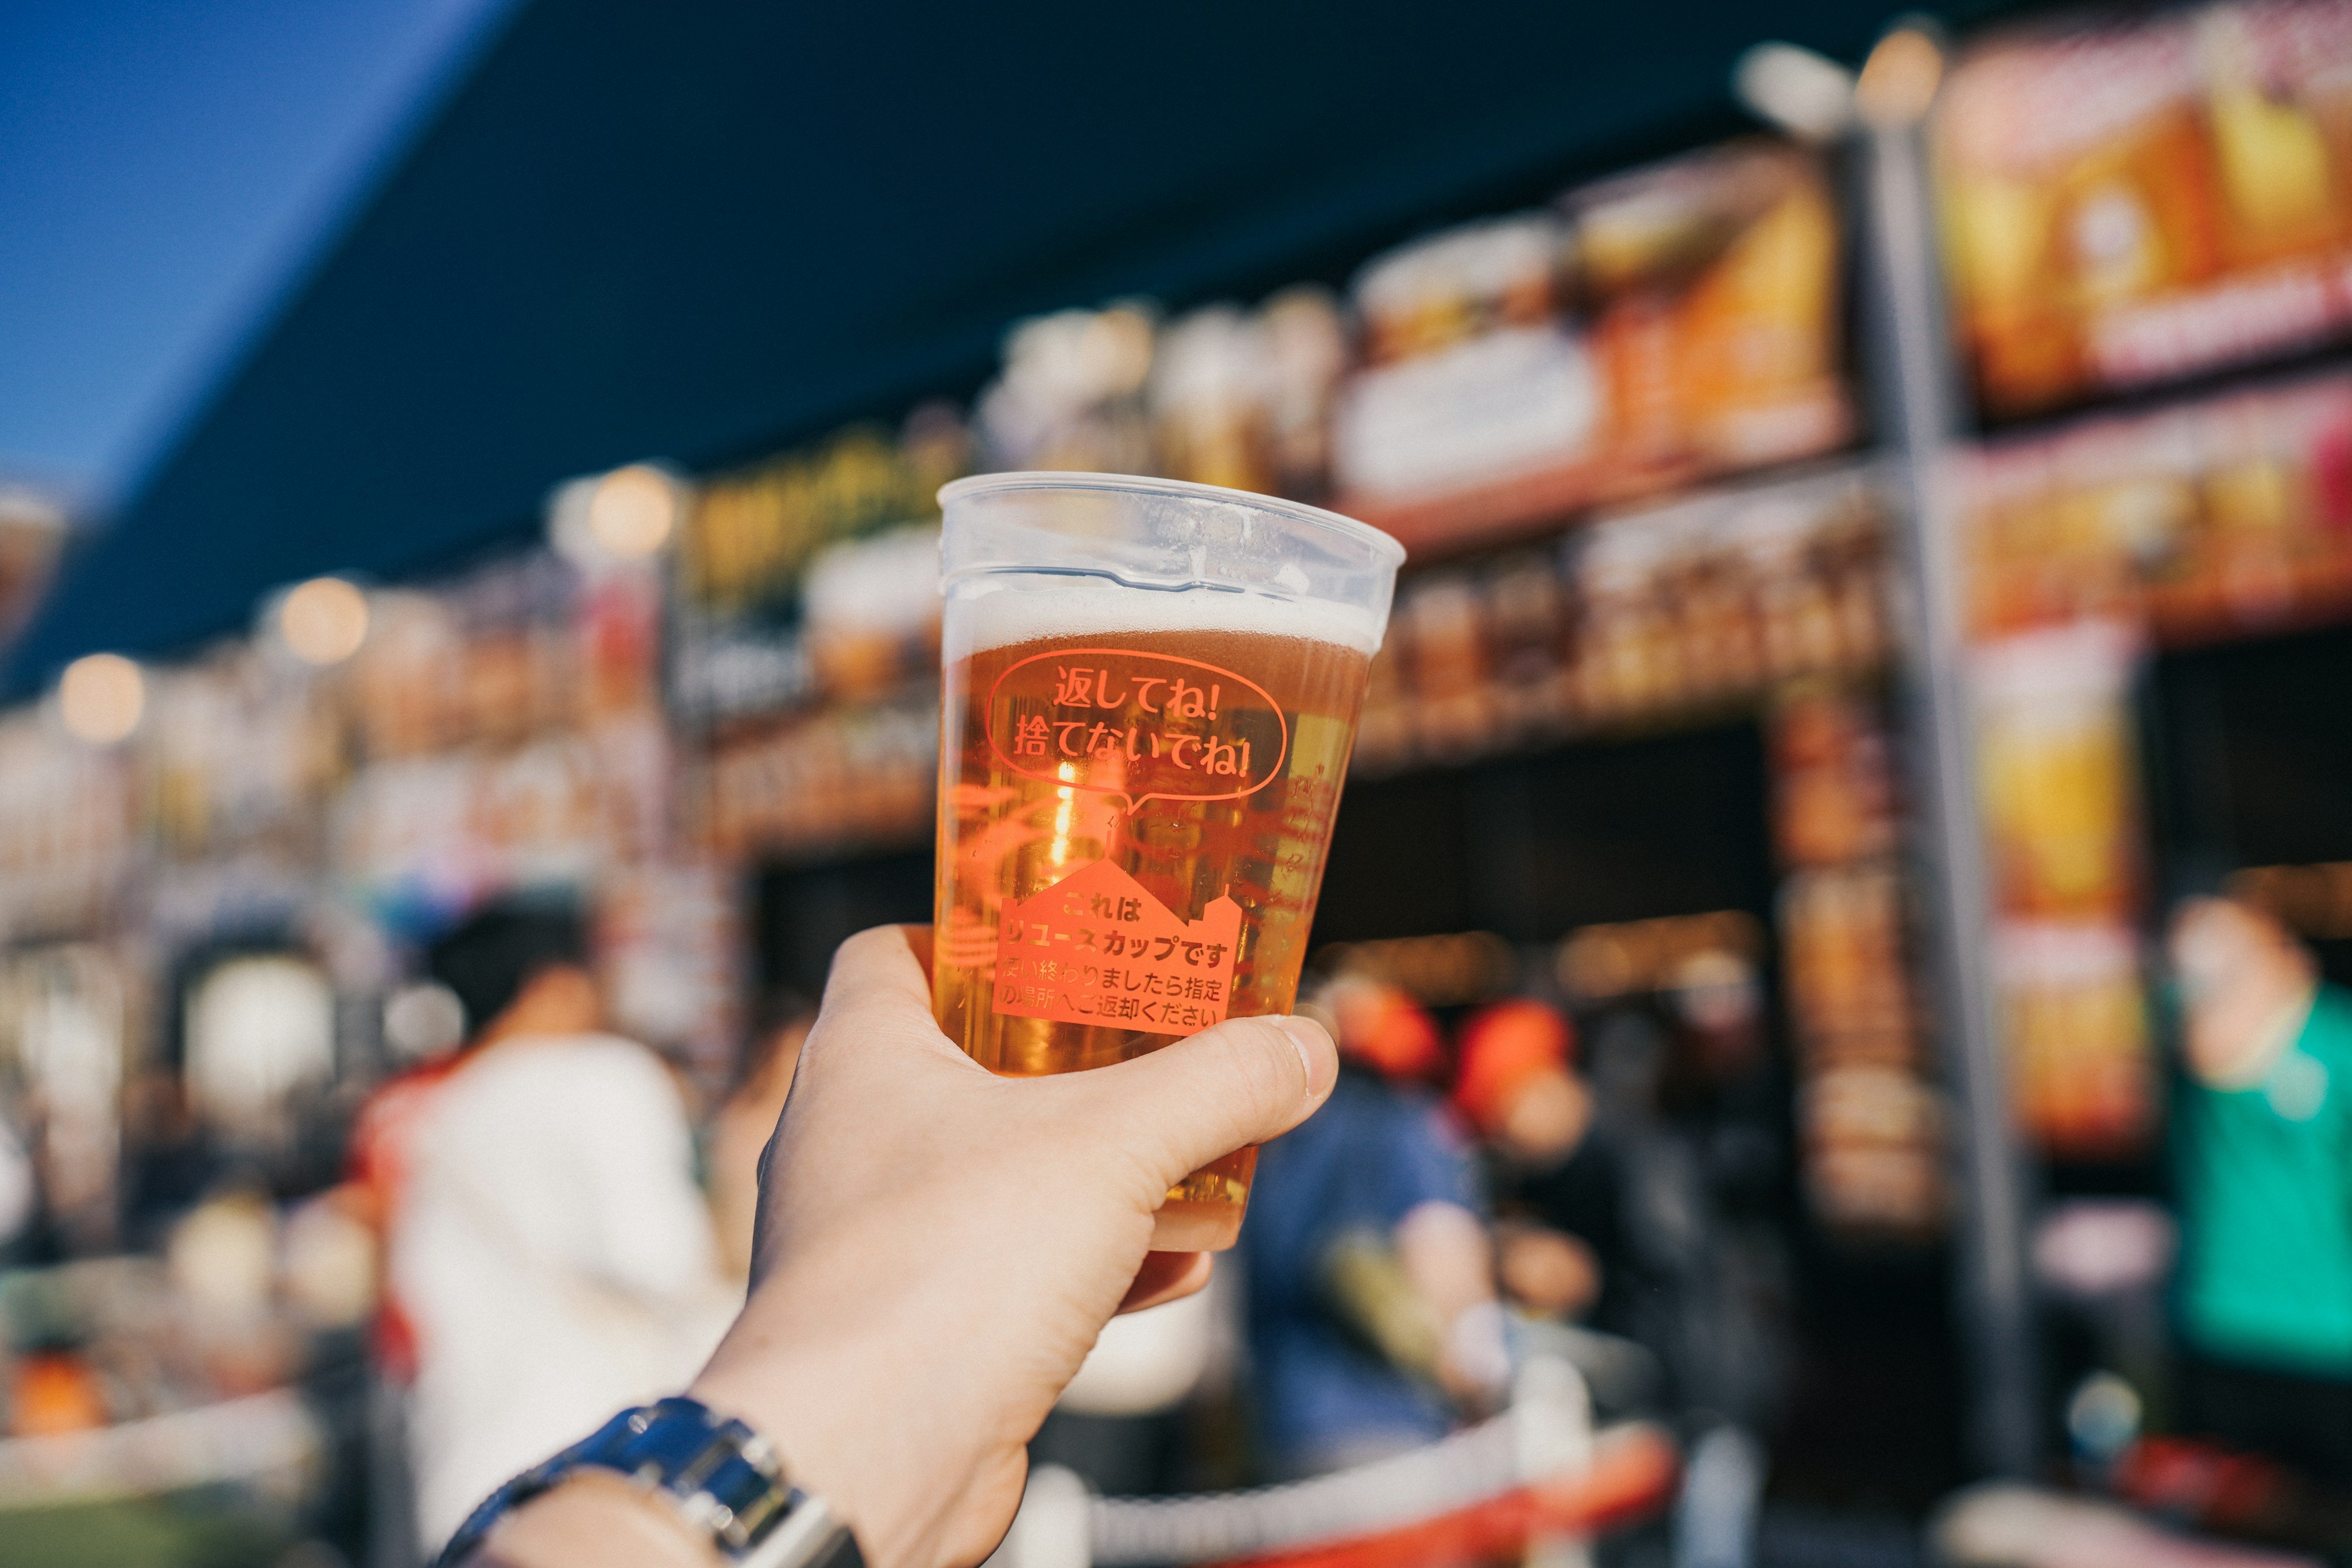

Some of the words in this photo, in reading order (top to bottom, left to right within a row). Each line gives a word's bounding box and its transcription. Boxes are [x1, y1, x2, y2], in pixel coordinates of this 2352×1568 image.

[1053, 665, 1220, 720] 返してね!
[1013, 714, 1250, 777] 捨てないでね!
[1063, 892, 1142, 922] これは
[1007, 919, 1228, 969] リユースカップです
[1001, 955, 1222, 1002] 使い終わりましたら指定
[999, 984, 1217, 1028] の場所へご返却ください
